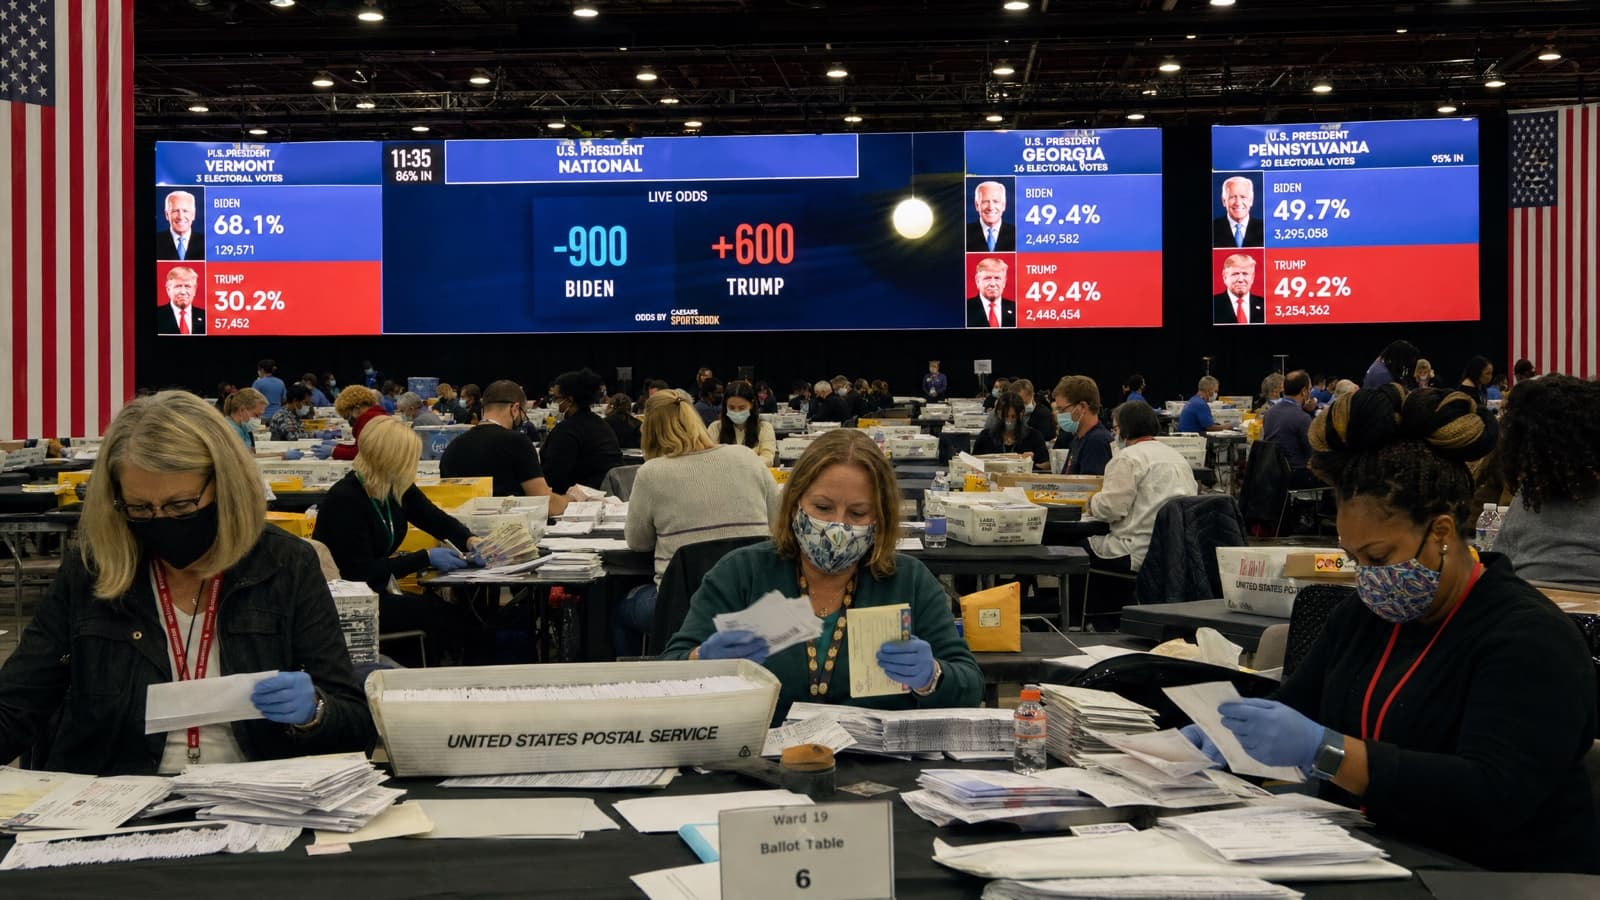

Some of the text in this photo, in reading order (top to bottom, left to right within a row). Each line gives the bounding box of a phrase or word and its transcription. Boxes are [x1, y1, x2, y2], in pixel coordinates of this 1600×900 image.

[1024, 136, 1101, 147] U.S. PRESIDENT
[1269, 130, 1349, 142] U.S. PRESIDENT
[225, 148, 271, 158] PRESIDENT
[556, 143, 645, 157] U.S. PRESIDENT
[1022, 147, 1105, 162] GEORGIA
[1248, 140, 1370, 157] PENNSYLVANIA
[391, 149, 432, 168] 11:35
[1260, 156, 1356, 168] 20 ELECTORAL VOTES
[1431, 153, 1464, 163] 95% IN
[204, 159, 275, 172] VERMONT
[558, 158, 643, 174] NATIONAL
[1014, 162, 1109, 173] 16 ELECTORAL VOTES
[195, 174, 284, 183] 3 ELECTORAL VOTES
[395, 170, 432, 182] 86% IN
[1025, 188, 1053, 199] BIDEN
[1273, 183, 1302, 193] BIDEN
[648, 190, 708, 203] LIVE ODDS
[213, 198, 241, 209] BIDEN
[1273, 199, 1351, 221] 49.7%
[1025, 204, 1101, 225] 49.4%
[213, 215, 285, 236] 68.1%
[1025, 233, 1080, 246] 2,449,582
[1274, 228, 1329, 241] 3,295,058
[215, 244, 254, 256] 129,571
[553, 222, 795, 267] -900 +600
[1026, 264, 1058, 275] TRUMP
[1274, 259, 1307, 271] TRUMP
[214, 274, 245, 285] TRUMP
[564, 277, 785, 298] BIDEN TRUMP
[1025, 281, 1102, 303] 49.4%
[1273, 276, 1352, 298] 49.2%
[214, 290, 286, 311] 30.2%
[670, 308, 699, 316] CAESARS
[1026, 308, 1081, 321] 2,448,454
[1274, 304, 1331, 317] 3,254,362
[214, 317, 250, 330] 57,452
[634, 313, 667, 322] ODDS BY
[670, 315, 720, 326] SPORTSBOOK
[1258, 583, 1283, 594] STATES
[447, 726, 718, 749] UNITED STATES POSTAL SERVICE
[773, 811, 828, 825] Ward 19
[760, 837, 844, 855] Ballot Table
[795, 868, 811, 889] 6
